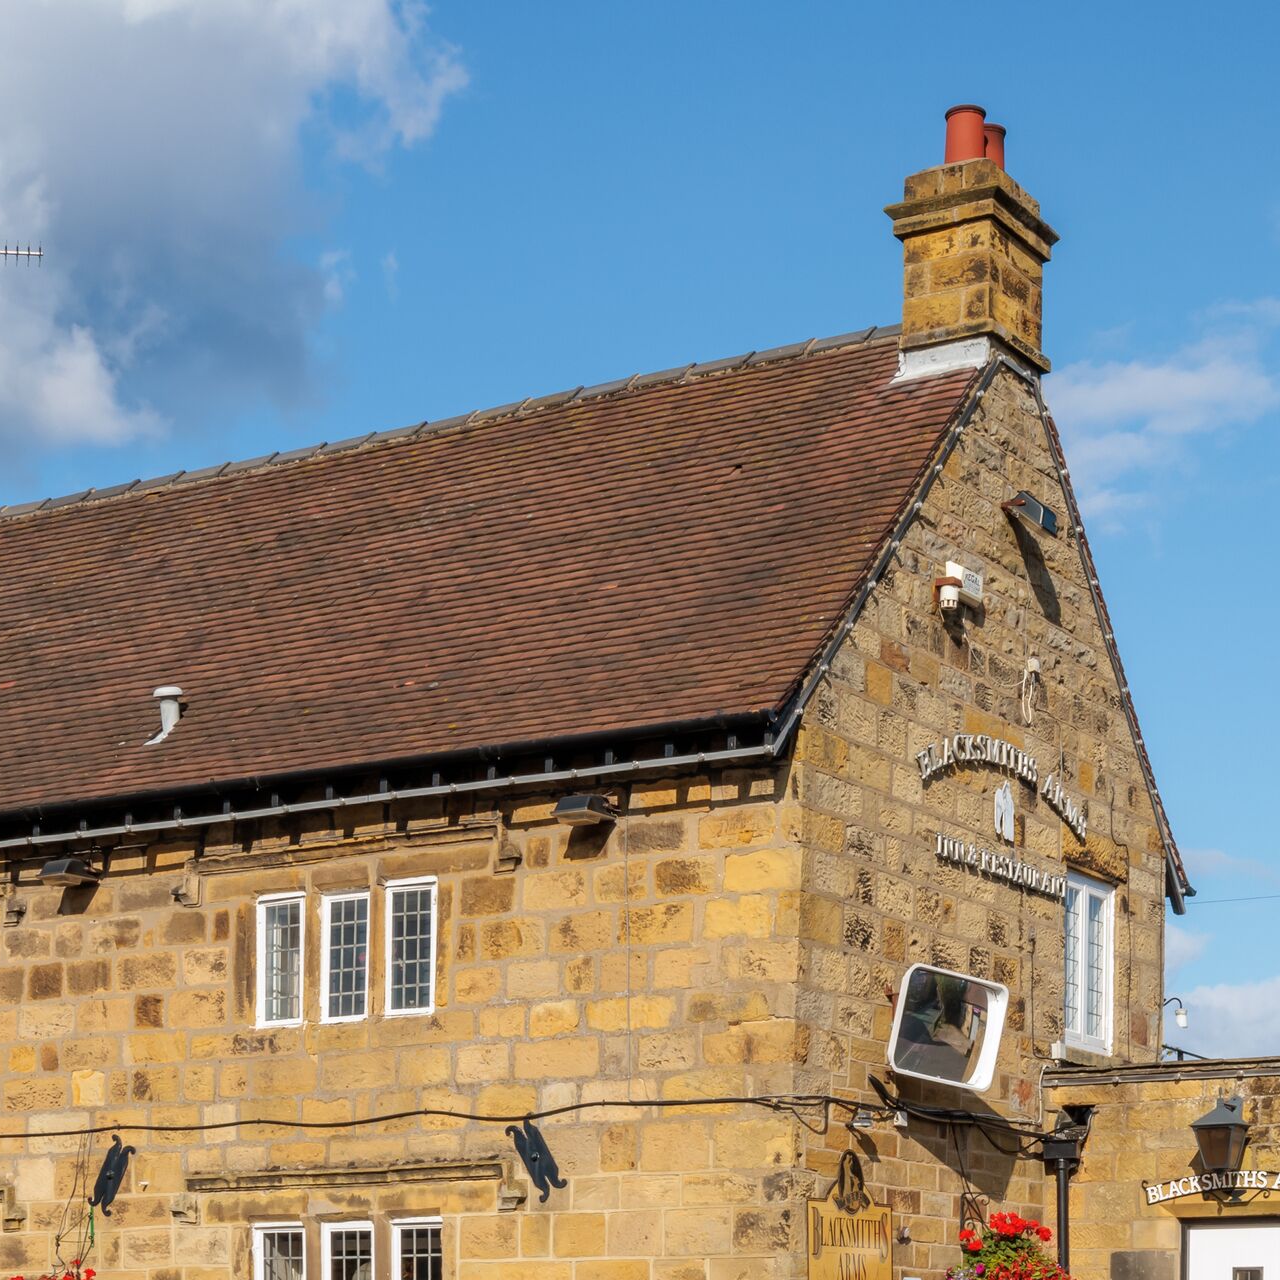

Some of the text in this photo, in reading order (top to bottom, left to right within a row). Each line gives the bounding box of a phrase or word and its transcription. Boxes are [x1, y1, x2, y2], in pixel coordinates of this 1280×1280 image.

[916, 735, 1087, 838] BLACKSMITHS ARMS
[935, 832, 1066, 897] INN & RESTAURANT
[1146, 1171, 1267, 1204] BLACKSMITHS
[812, 1207, 888, 1259] BLACKSMITHS
